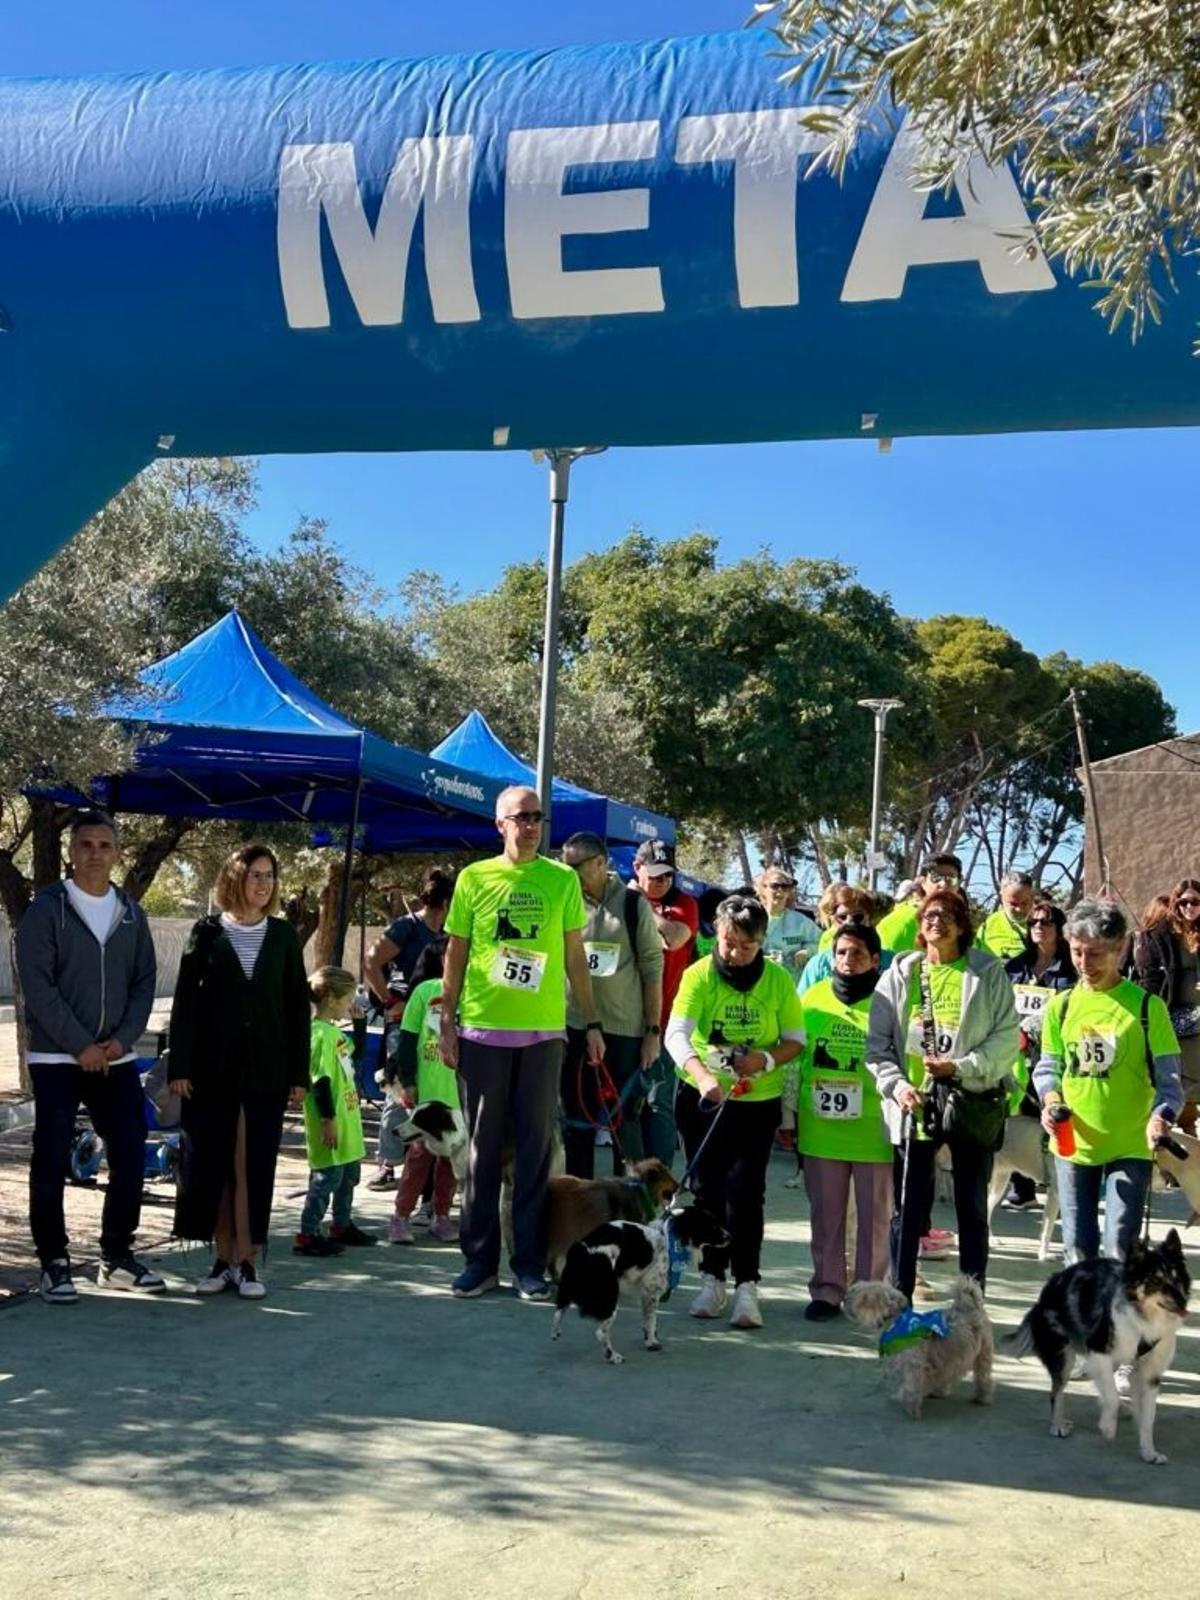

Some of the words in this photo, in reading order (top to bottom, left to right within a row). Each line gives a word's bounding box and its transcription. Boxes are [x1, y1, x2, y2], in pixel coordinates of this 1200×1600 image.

[276, 106, 1057, 329] META
[503, 961, 532, 984] 55
[1024, 995, 1042, 1010] 18
[820, 1091, 849, 1112] 29
